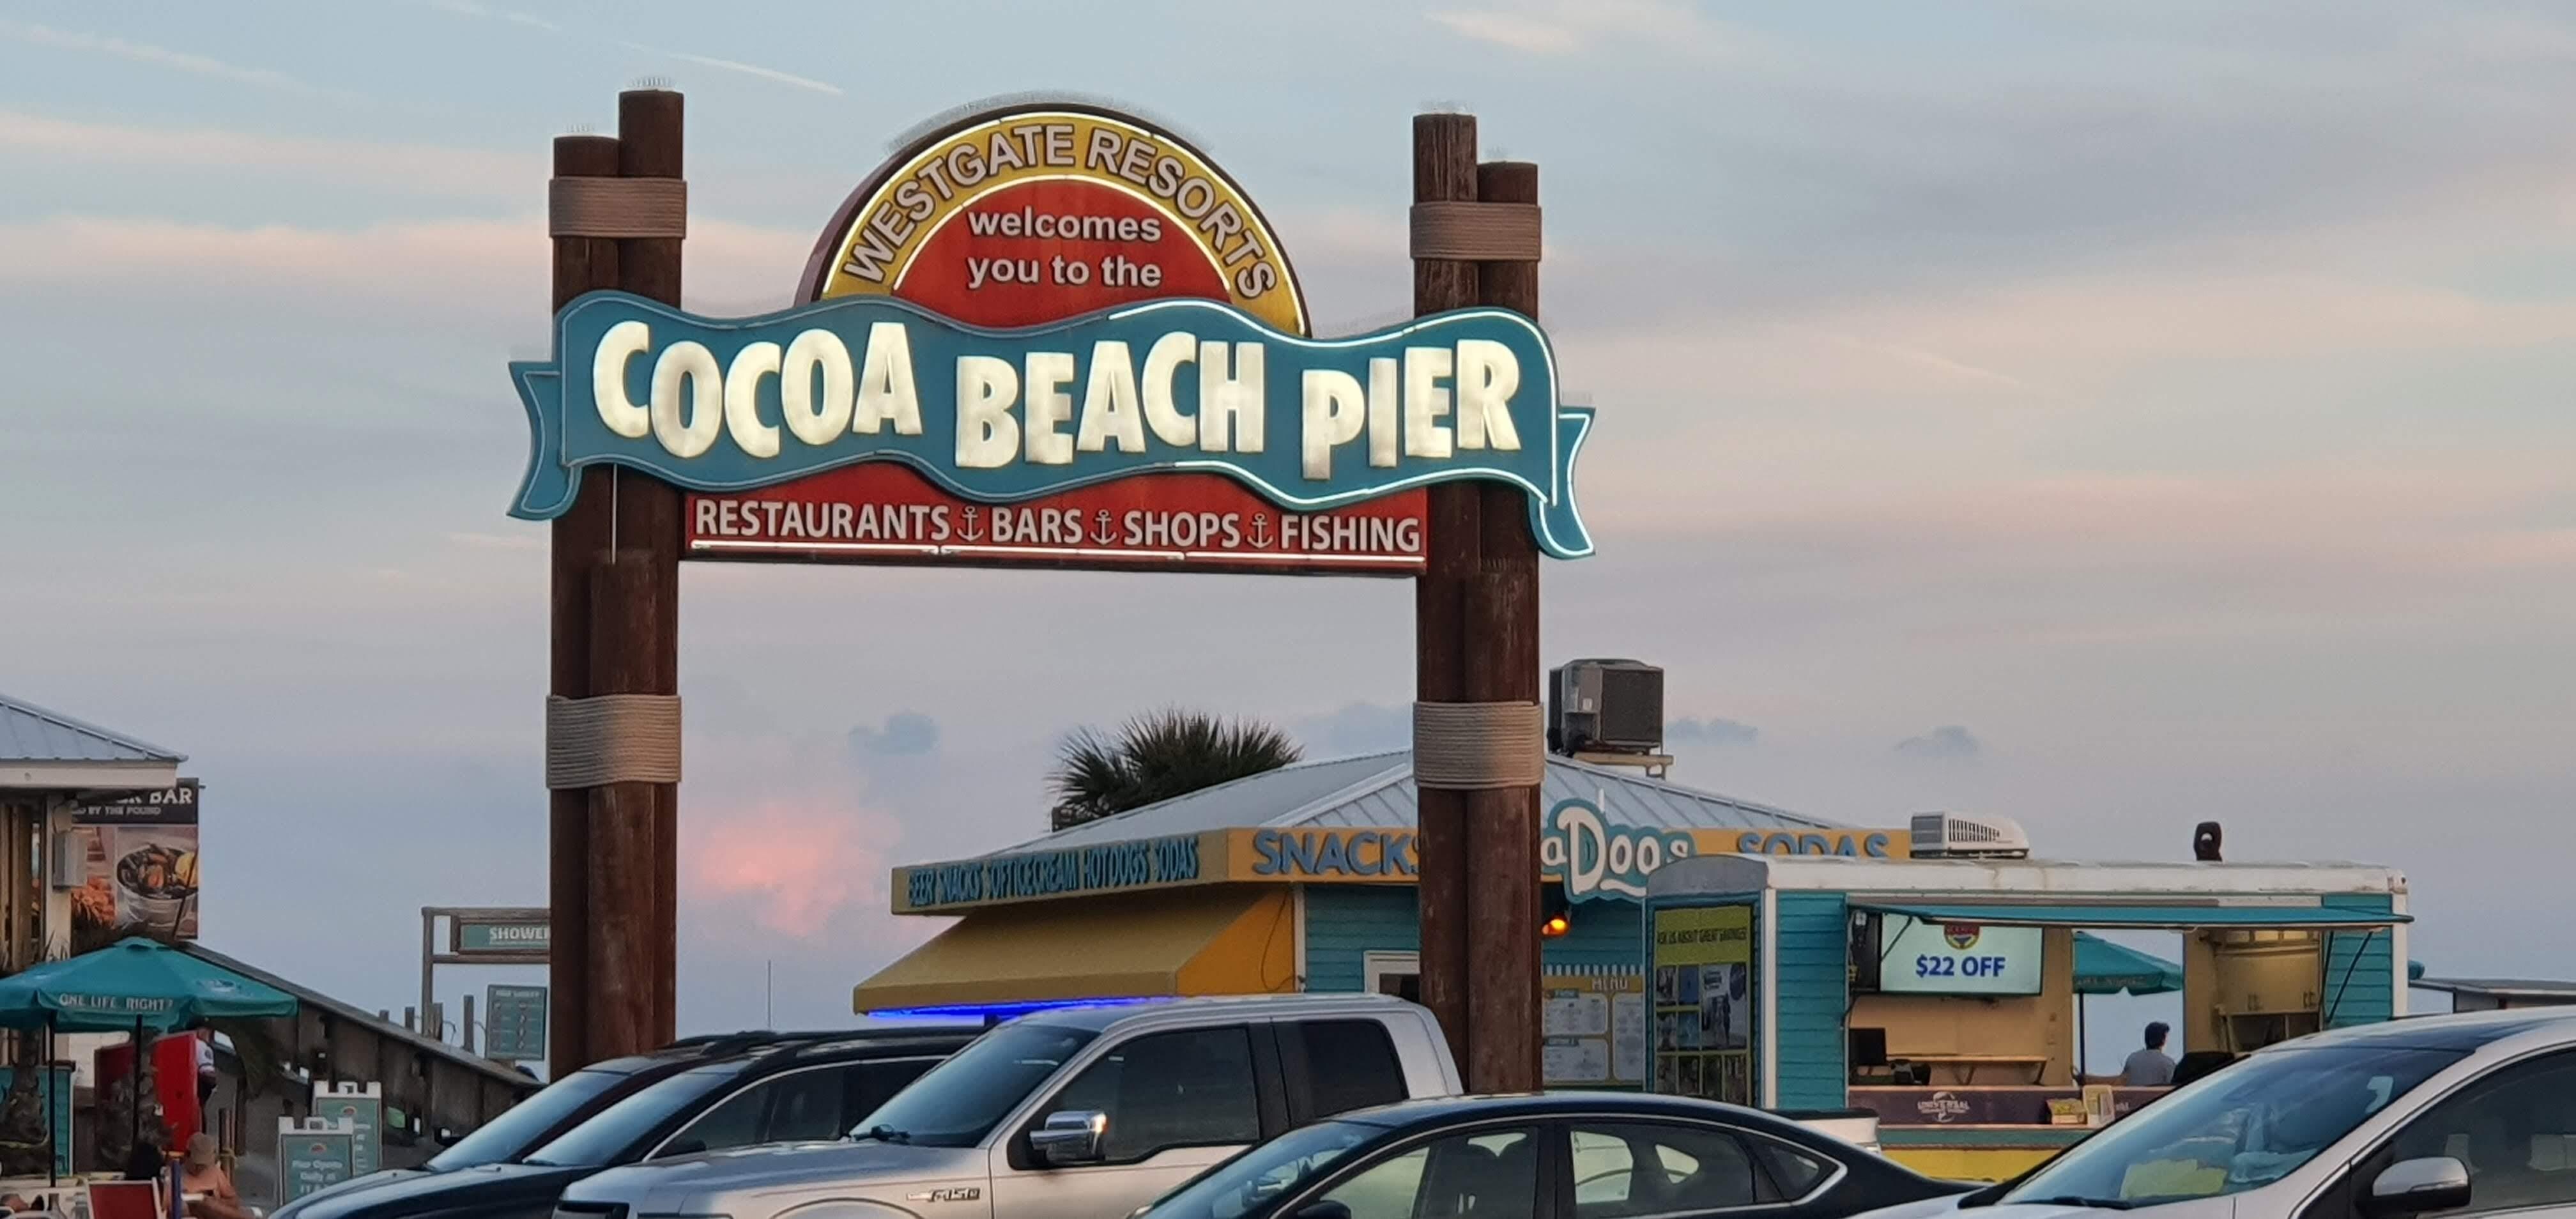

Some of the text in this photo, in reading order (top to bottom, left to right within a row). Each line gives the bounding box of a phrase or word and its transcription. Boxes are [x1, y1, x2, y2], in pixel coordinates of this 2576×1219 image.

[844, 125, 1276, 300] WESTGATE RESORTS
[968, 204, 1162, 241] welcomes
[967, 255, 1162, 289] you to the
[593, 320, 1522, 480] COCOA BEACH PIER
[696, 499, 1421, 553] RESTAURANTS BARS SHOPS FISHING
[149, 787, 192, 804] BAR
[908, 868, 936, 907] BEER
[937, 862, 985, 903] SNACKS
[1153, 838, 1199, 881] SODAS
[1252, 829, 1418, 875] SNACK
[1917, 954, 2006, 977] $22 OFF
[59, 993, 84, 1006] ONE
[91, 995, 117, 1009] LIFE
